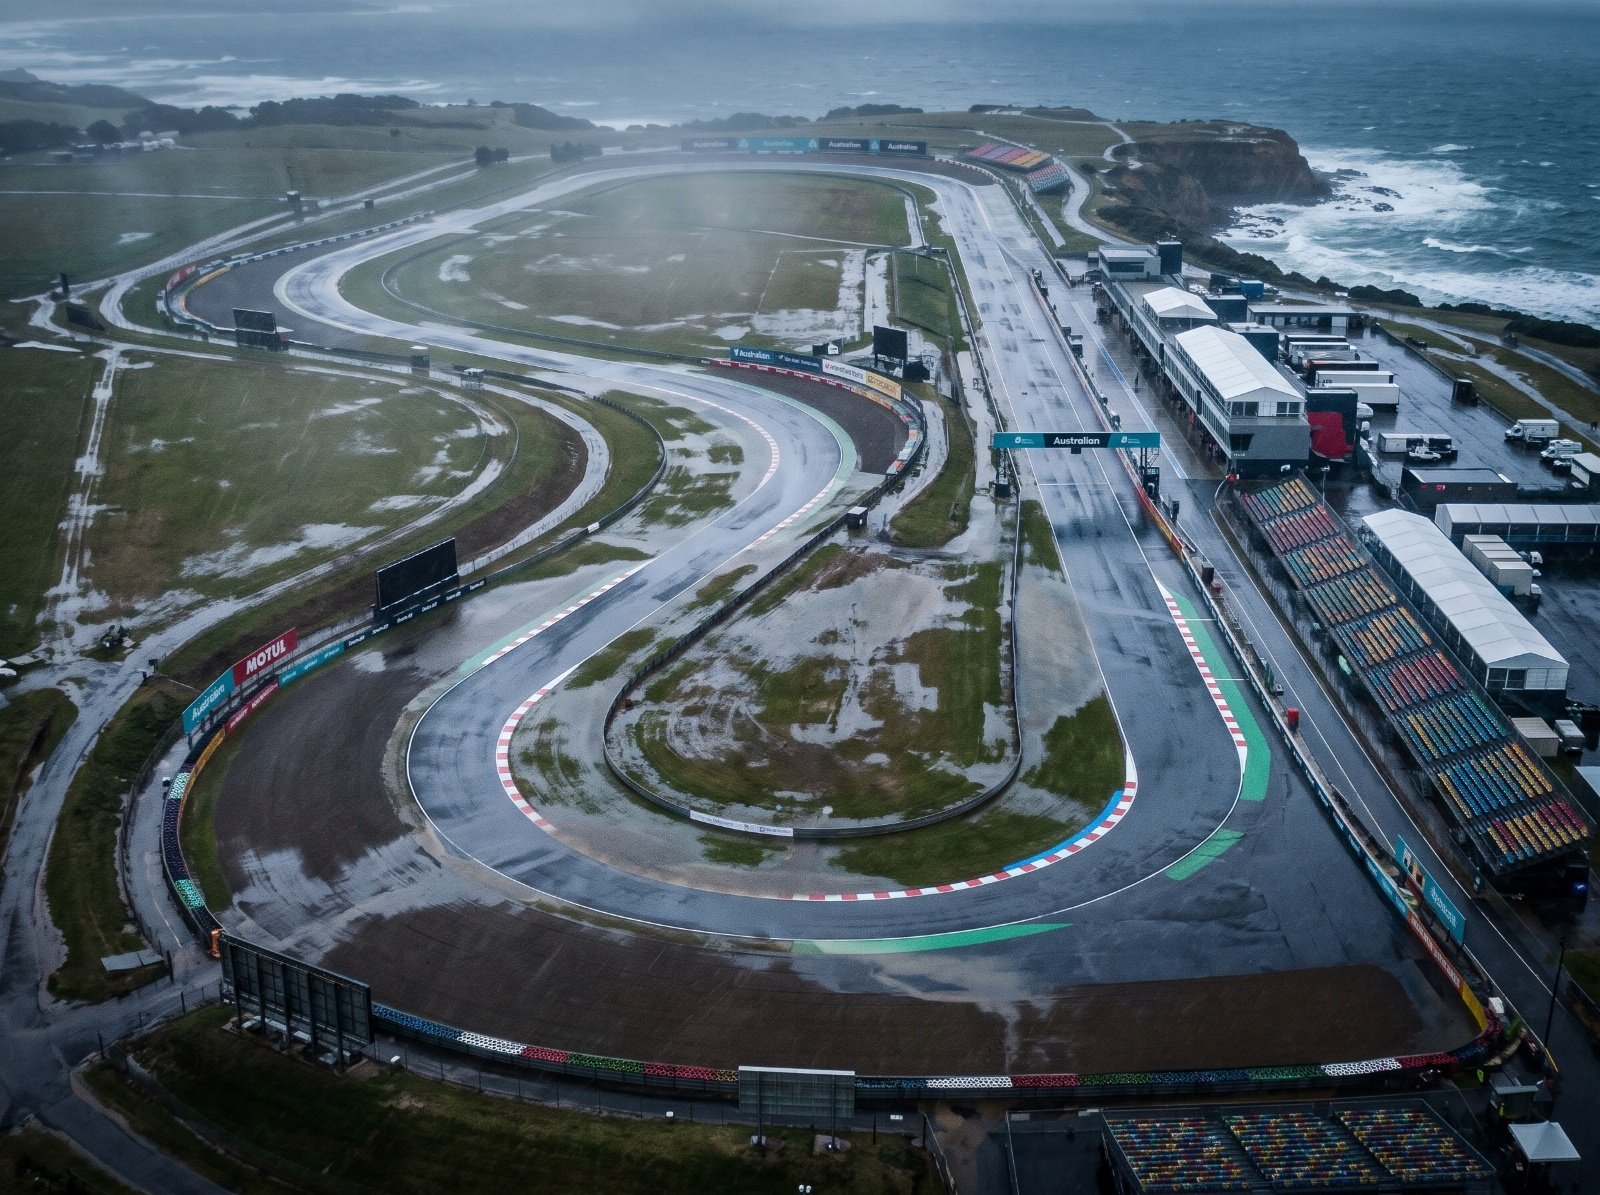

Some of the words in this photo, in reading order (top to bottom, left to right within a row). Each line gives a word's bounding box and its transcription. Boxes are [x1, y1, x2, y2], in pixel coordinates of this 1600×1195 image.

[888, 143, 918, 151] Australian
[1053, 436, 1100, 445] Australian
[246, 639, 286, 675] MOTUL
